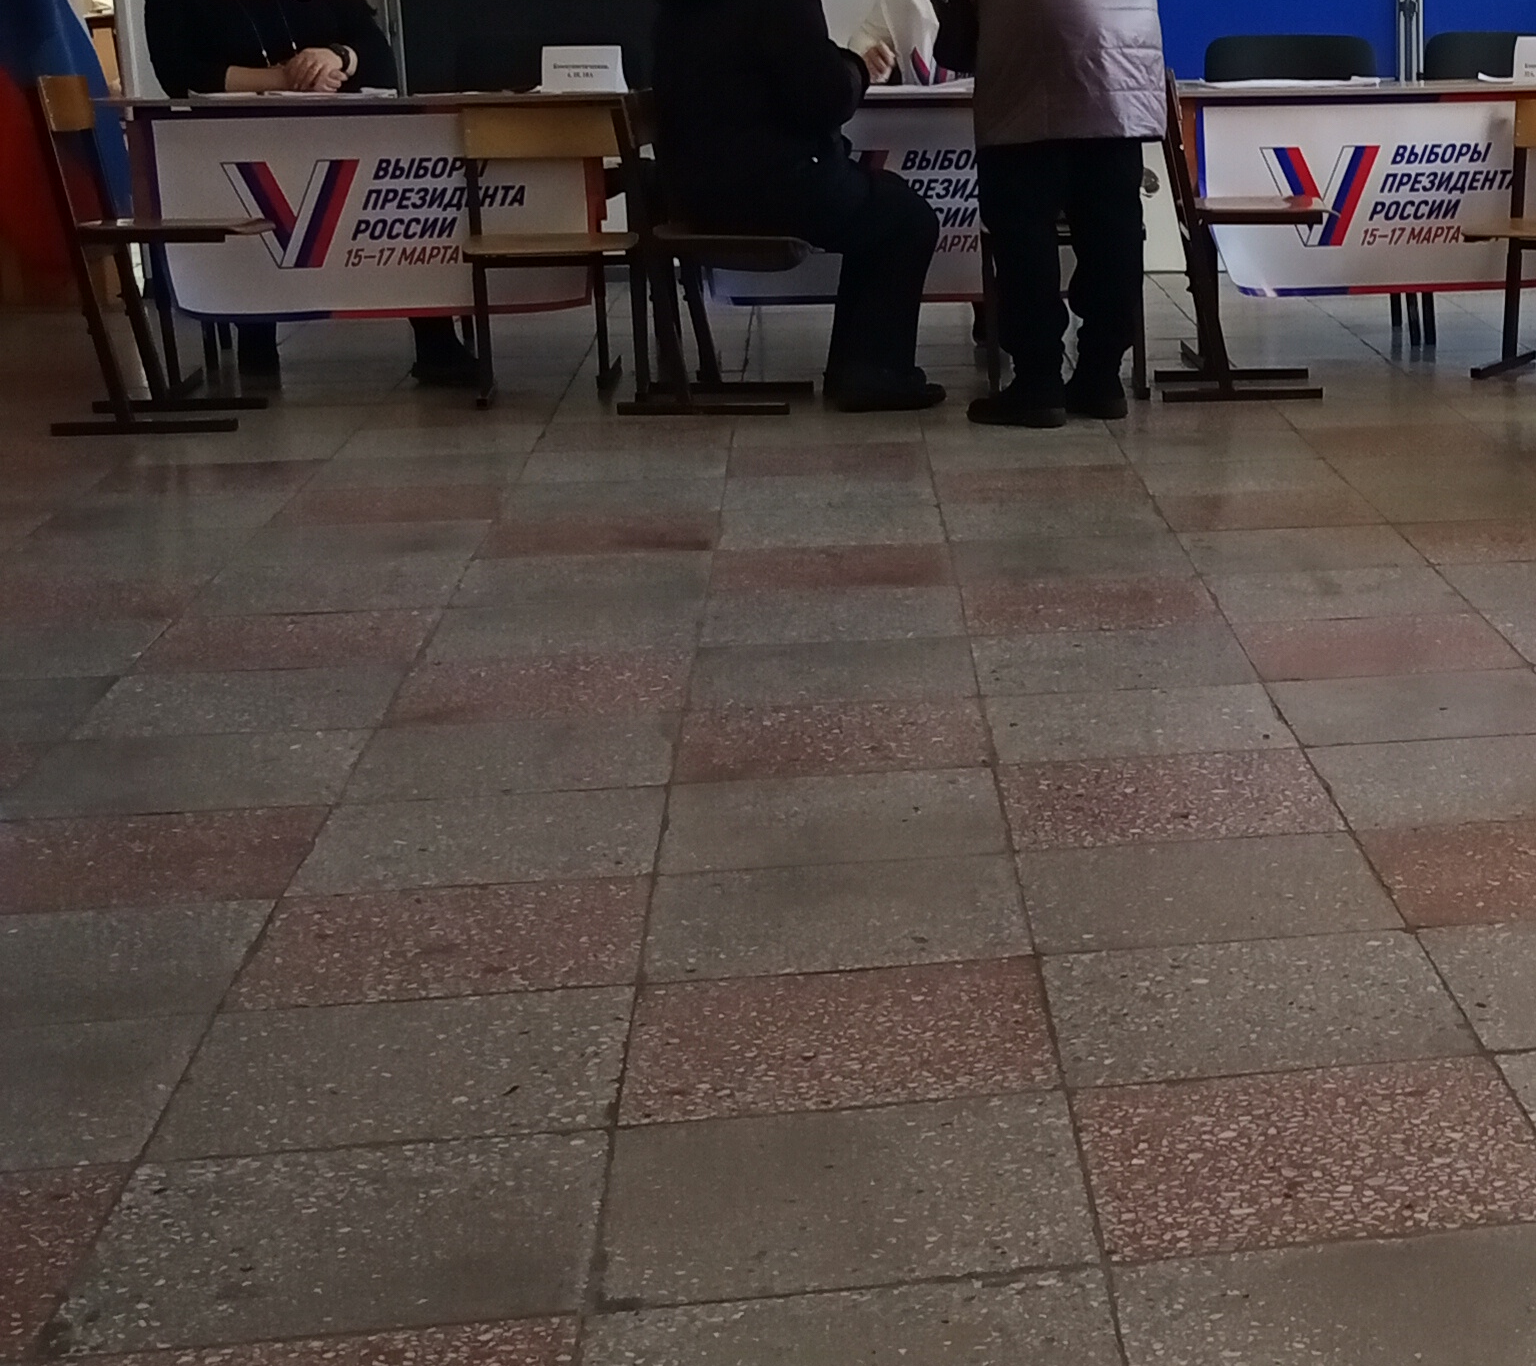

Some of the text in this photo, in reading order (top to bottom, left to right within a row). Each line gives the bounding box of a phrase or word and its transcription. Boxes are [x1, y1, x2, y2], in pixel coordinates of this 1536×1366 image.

[902, 149, 977, 171] ВЫБО
[1390, 143, 1493, 165] ВЫБОРЫ
[362, 185, 527, 212] ПРЕЗИДНТА
[905, 178, 979, 202] РЕЗИД
[1368, 199, 1462, 221] РОССИИ
[351, 216, 458, 241] РОССИИ
[1406, 226, 1462, 245] МАРТА
[935, 234, 978, 253] АРТА
[397, 245, 461, 266] МАРТА
